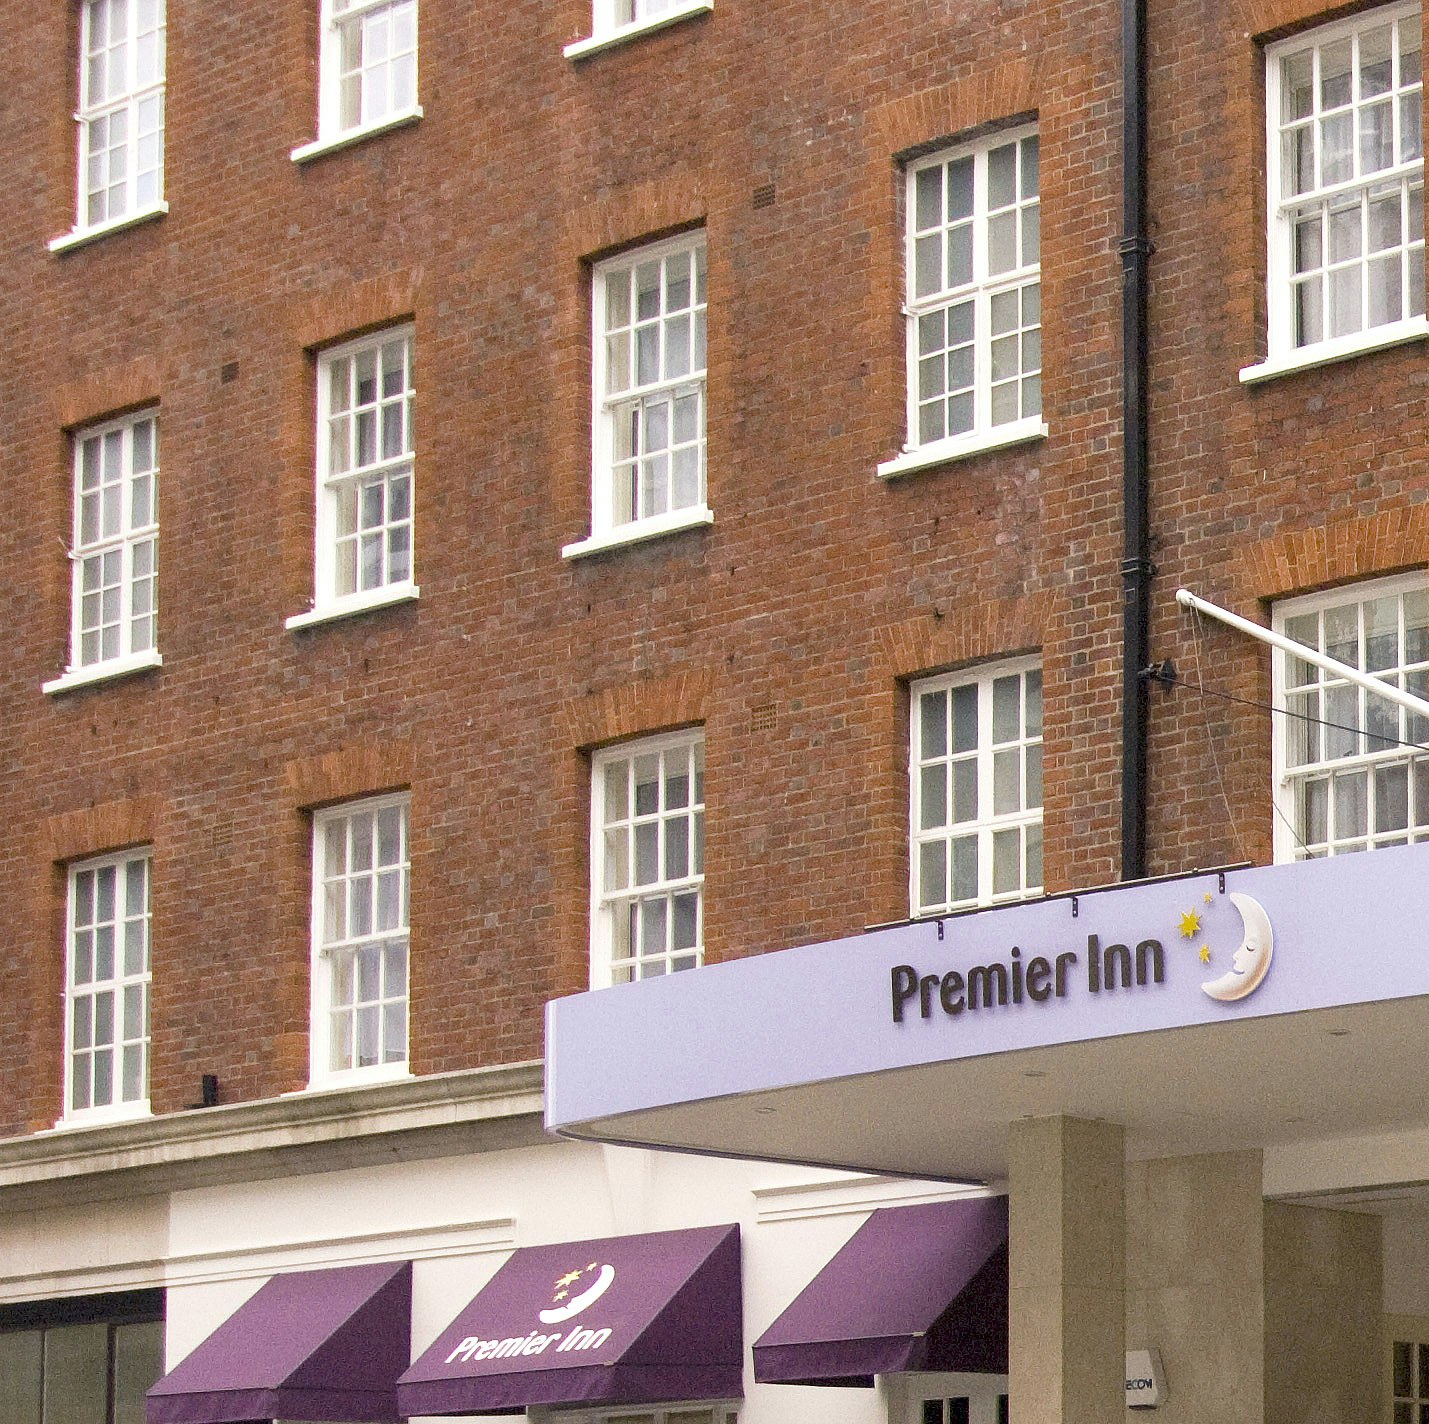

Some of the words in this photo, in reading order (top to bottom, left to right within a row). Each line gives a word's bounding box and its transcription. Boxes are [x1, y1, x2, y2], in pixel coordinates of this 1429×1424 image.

[891, 946, 1076, 1022] Premier
[1087, 935, 1165, 992] Inn
[445, 1331, 562, 1364] Premier
[556, 1325, 613, 1352] Inn
